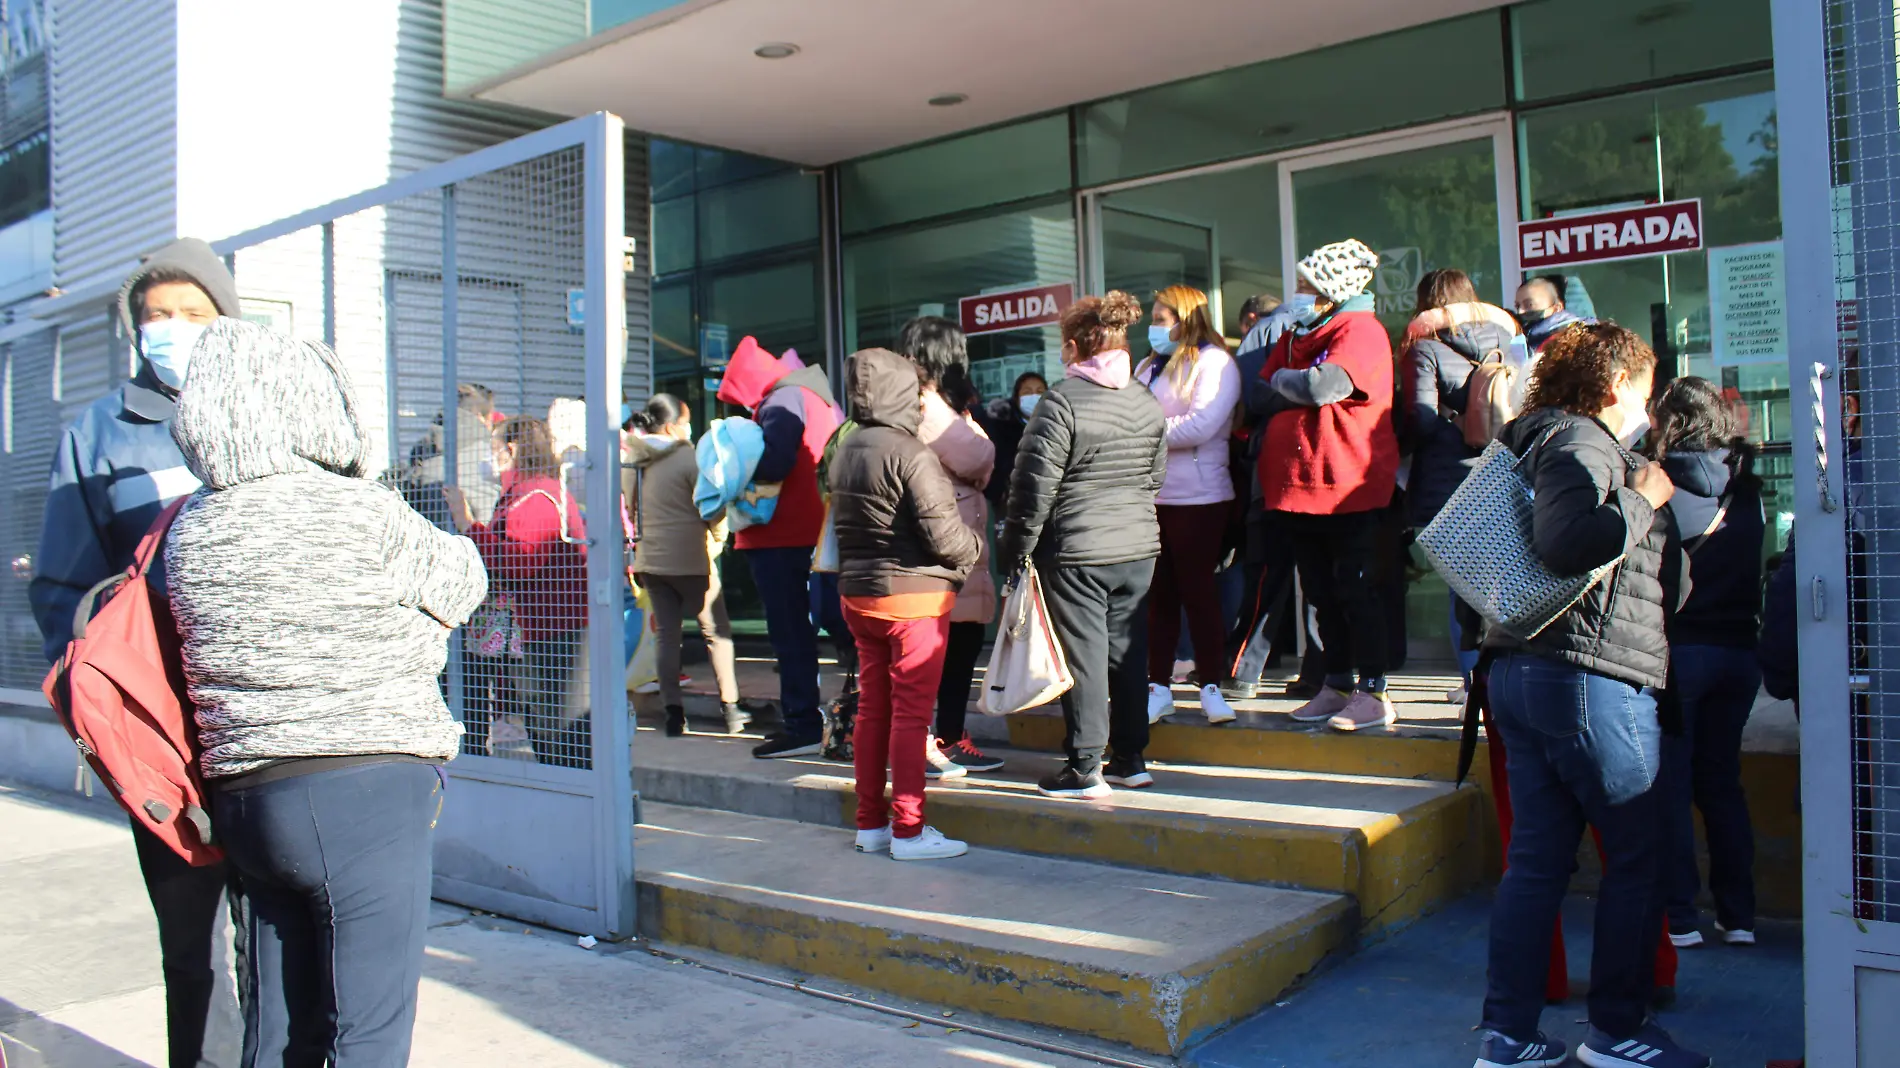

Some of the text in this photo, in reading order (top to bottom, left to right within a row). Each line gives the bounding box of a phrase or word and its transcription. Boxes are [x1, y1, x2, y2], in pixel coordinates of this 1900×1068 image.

[1522, 212, 1697, 259] ENTRADA
[1724, 252, 1775, 264] PACIENTES DEL
[1730, 262, 1771, 272] PROGRAMA
[975, 294, 1059, 325] SALIDA
[1376, 294, 1417, 315] IMS
[1729, 300, 1770, 311] NOVIEMBRE
[1725, 308, 1781, 321] DICIEMBRE 2022
[1730, 337, 1779, 348] A ACTUALIZAR
[1750, 347, 1774, 355] DATOS
